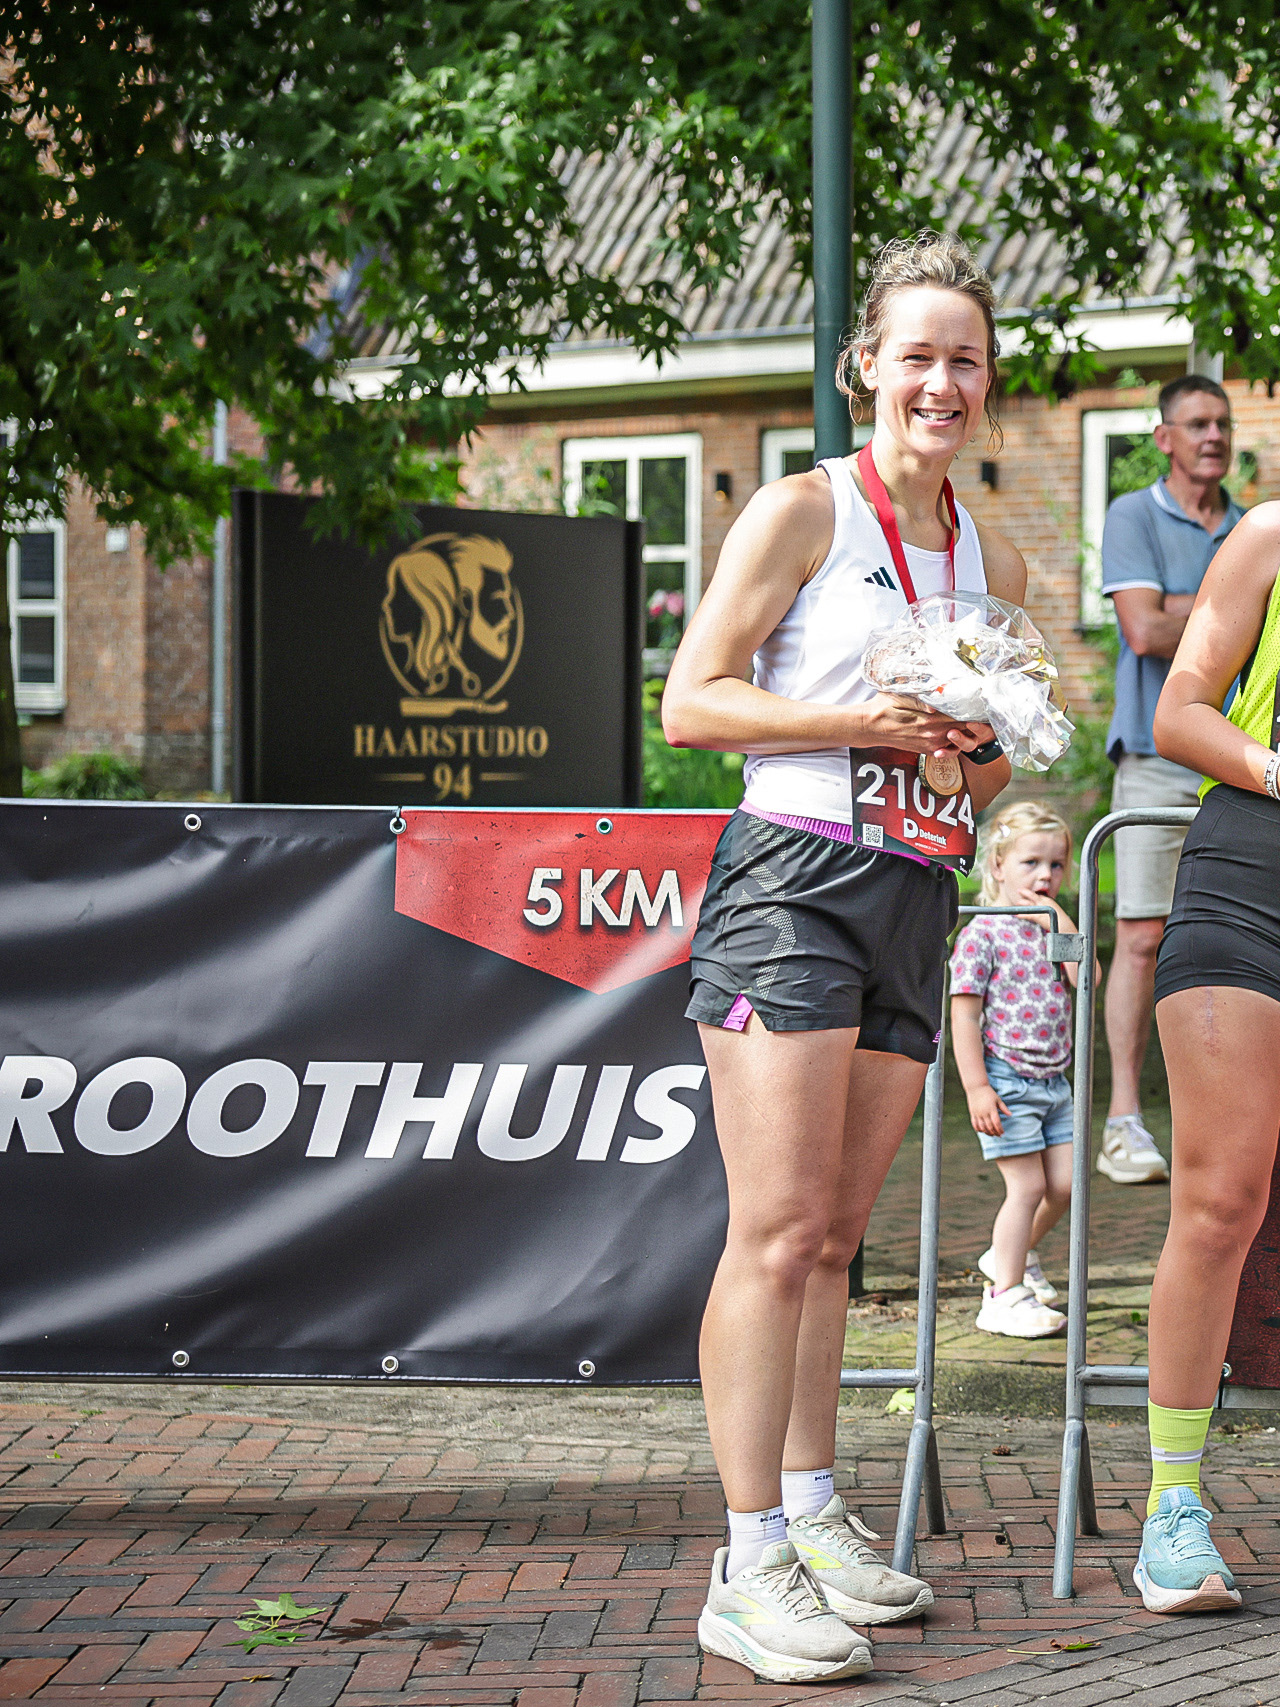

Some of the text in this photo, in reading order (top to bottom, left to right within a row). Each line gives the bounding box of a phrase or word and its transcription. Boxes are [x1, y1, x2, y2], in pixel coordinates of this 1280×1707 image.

[353, 724, 549, 759] HAARSTUDIO
[433, 764, 472, 800] 94
[856, 763, 974, 835] 21024
[522, 866, 685, 927] 5 KM
[0, 1055, 707, 1164] ROOTHUIS
